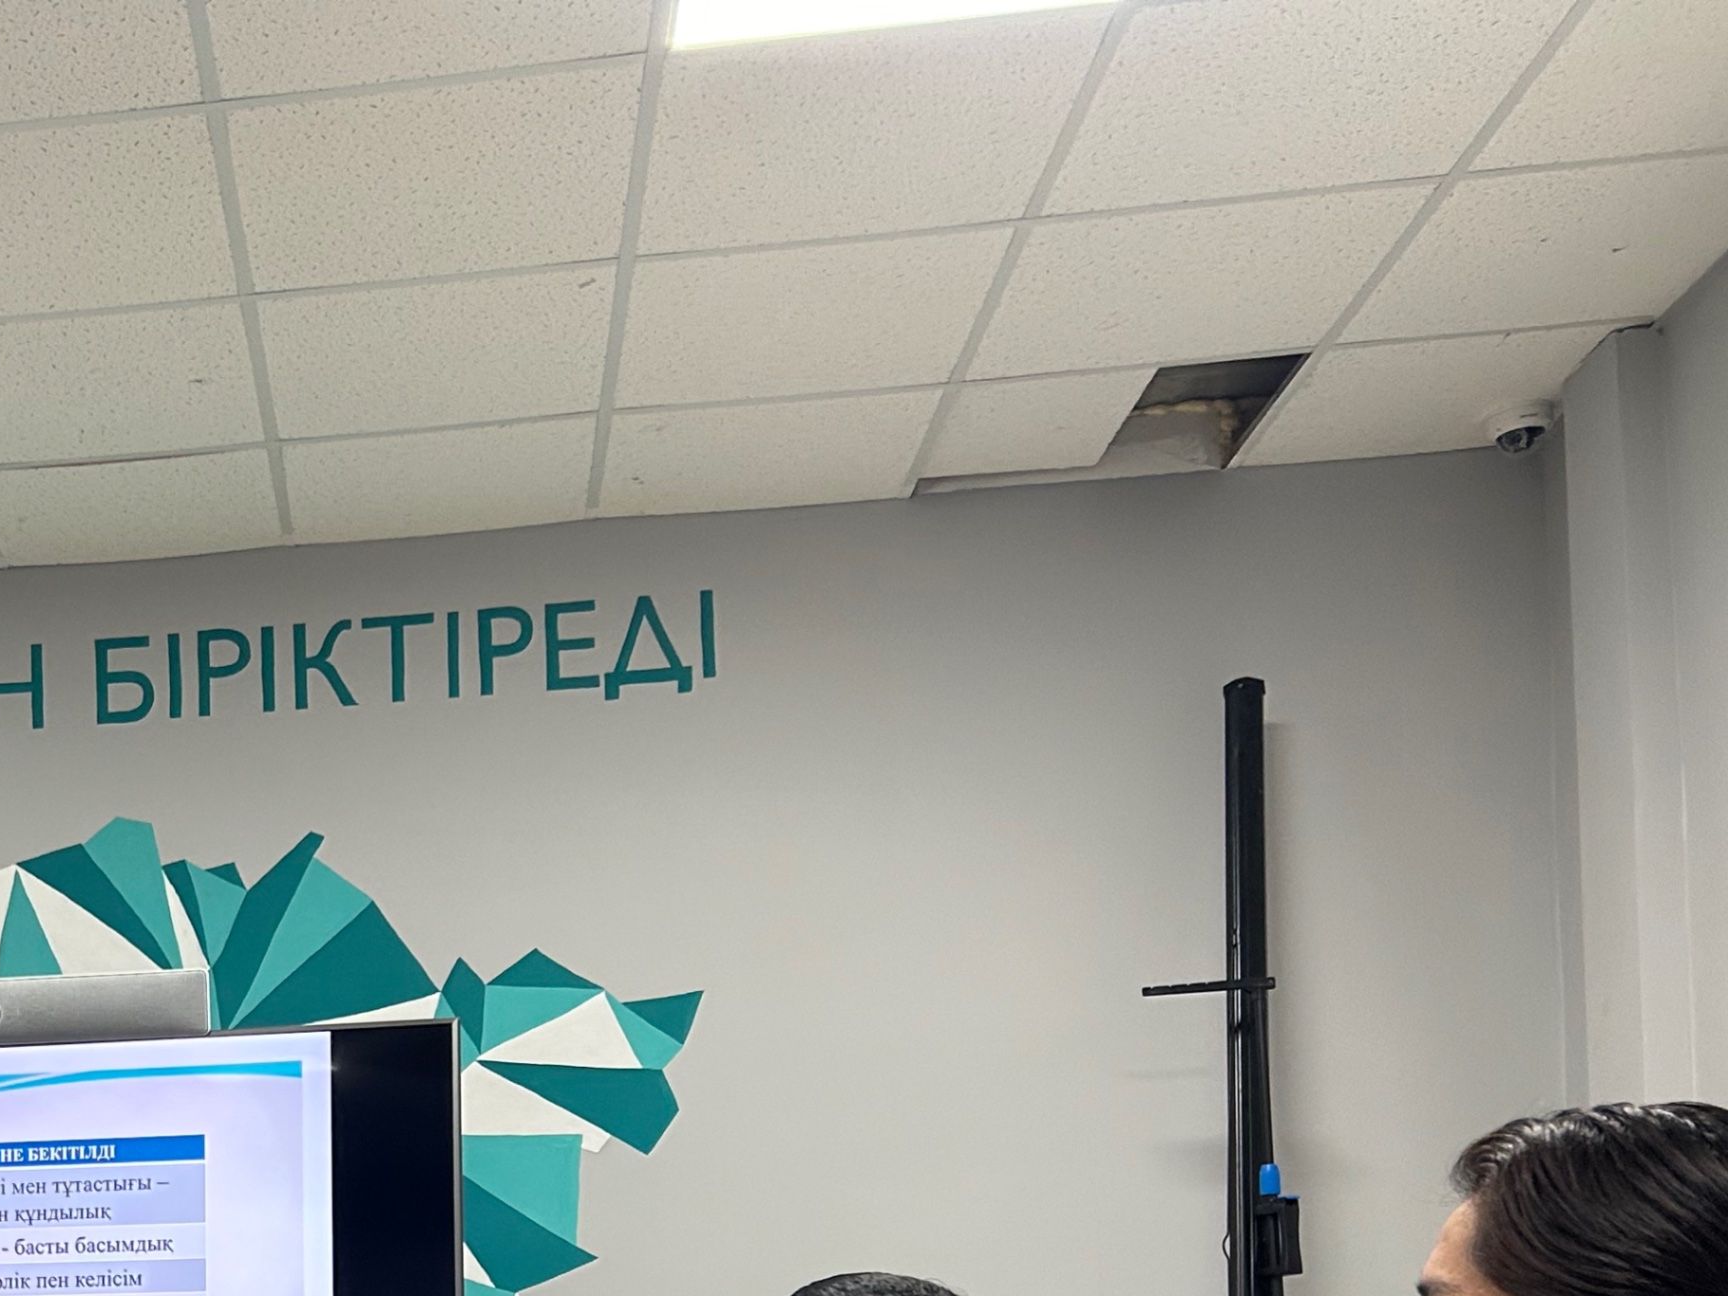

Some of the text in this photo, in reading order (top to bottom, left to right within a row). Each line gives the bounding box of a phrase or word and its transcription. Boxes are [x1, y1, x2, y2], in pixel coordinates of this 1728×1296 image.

[94, 589, 717, 725] БІРІКТІРЕДІ
[0, 1148, 23, 1163] НЕ
[27, 1145, 116, 1161] БЕКІТІЛДІ
[11, 1180, 47, 1194] мен
[52, 1177, 152, 1197] тұтастығы
[14, 1206, 113, 1225] құндылық
[14, 1238, 69, 1255] басты
[74, 1236, 175, 1253] басымдық
[36, 1274, 69, 1288] пен
[75, 1267, 143, 1287] келісім
